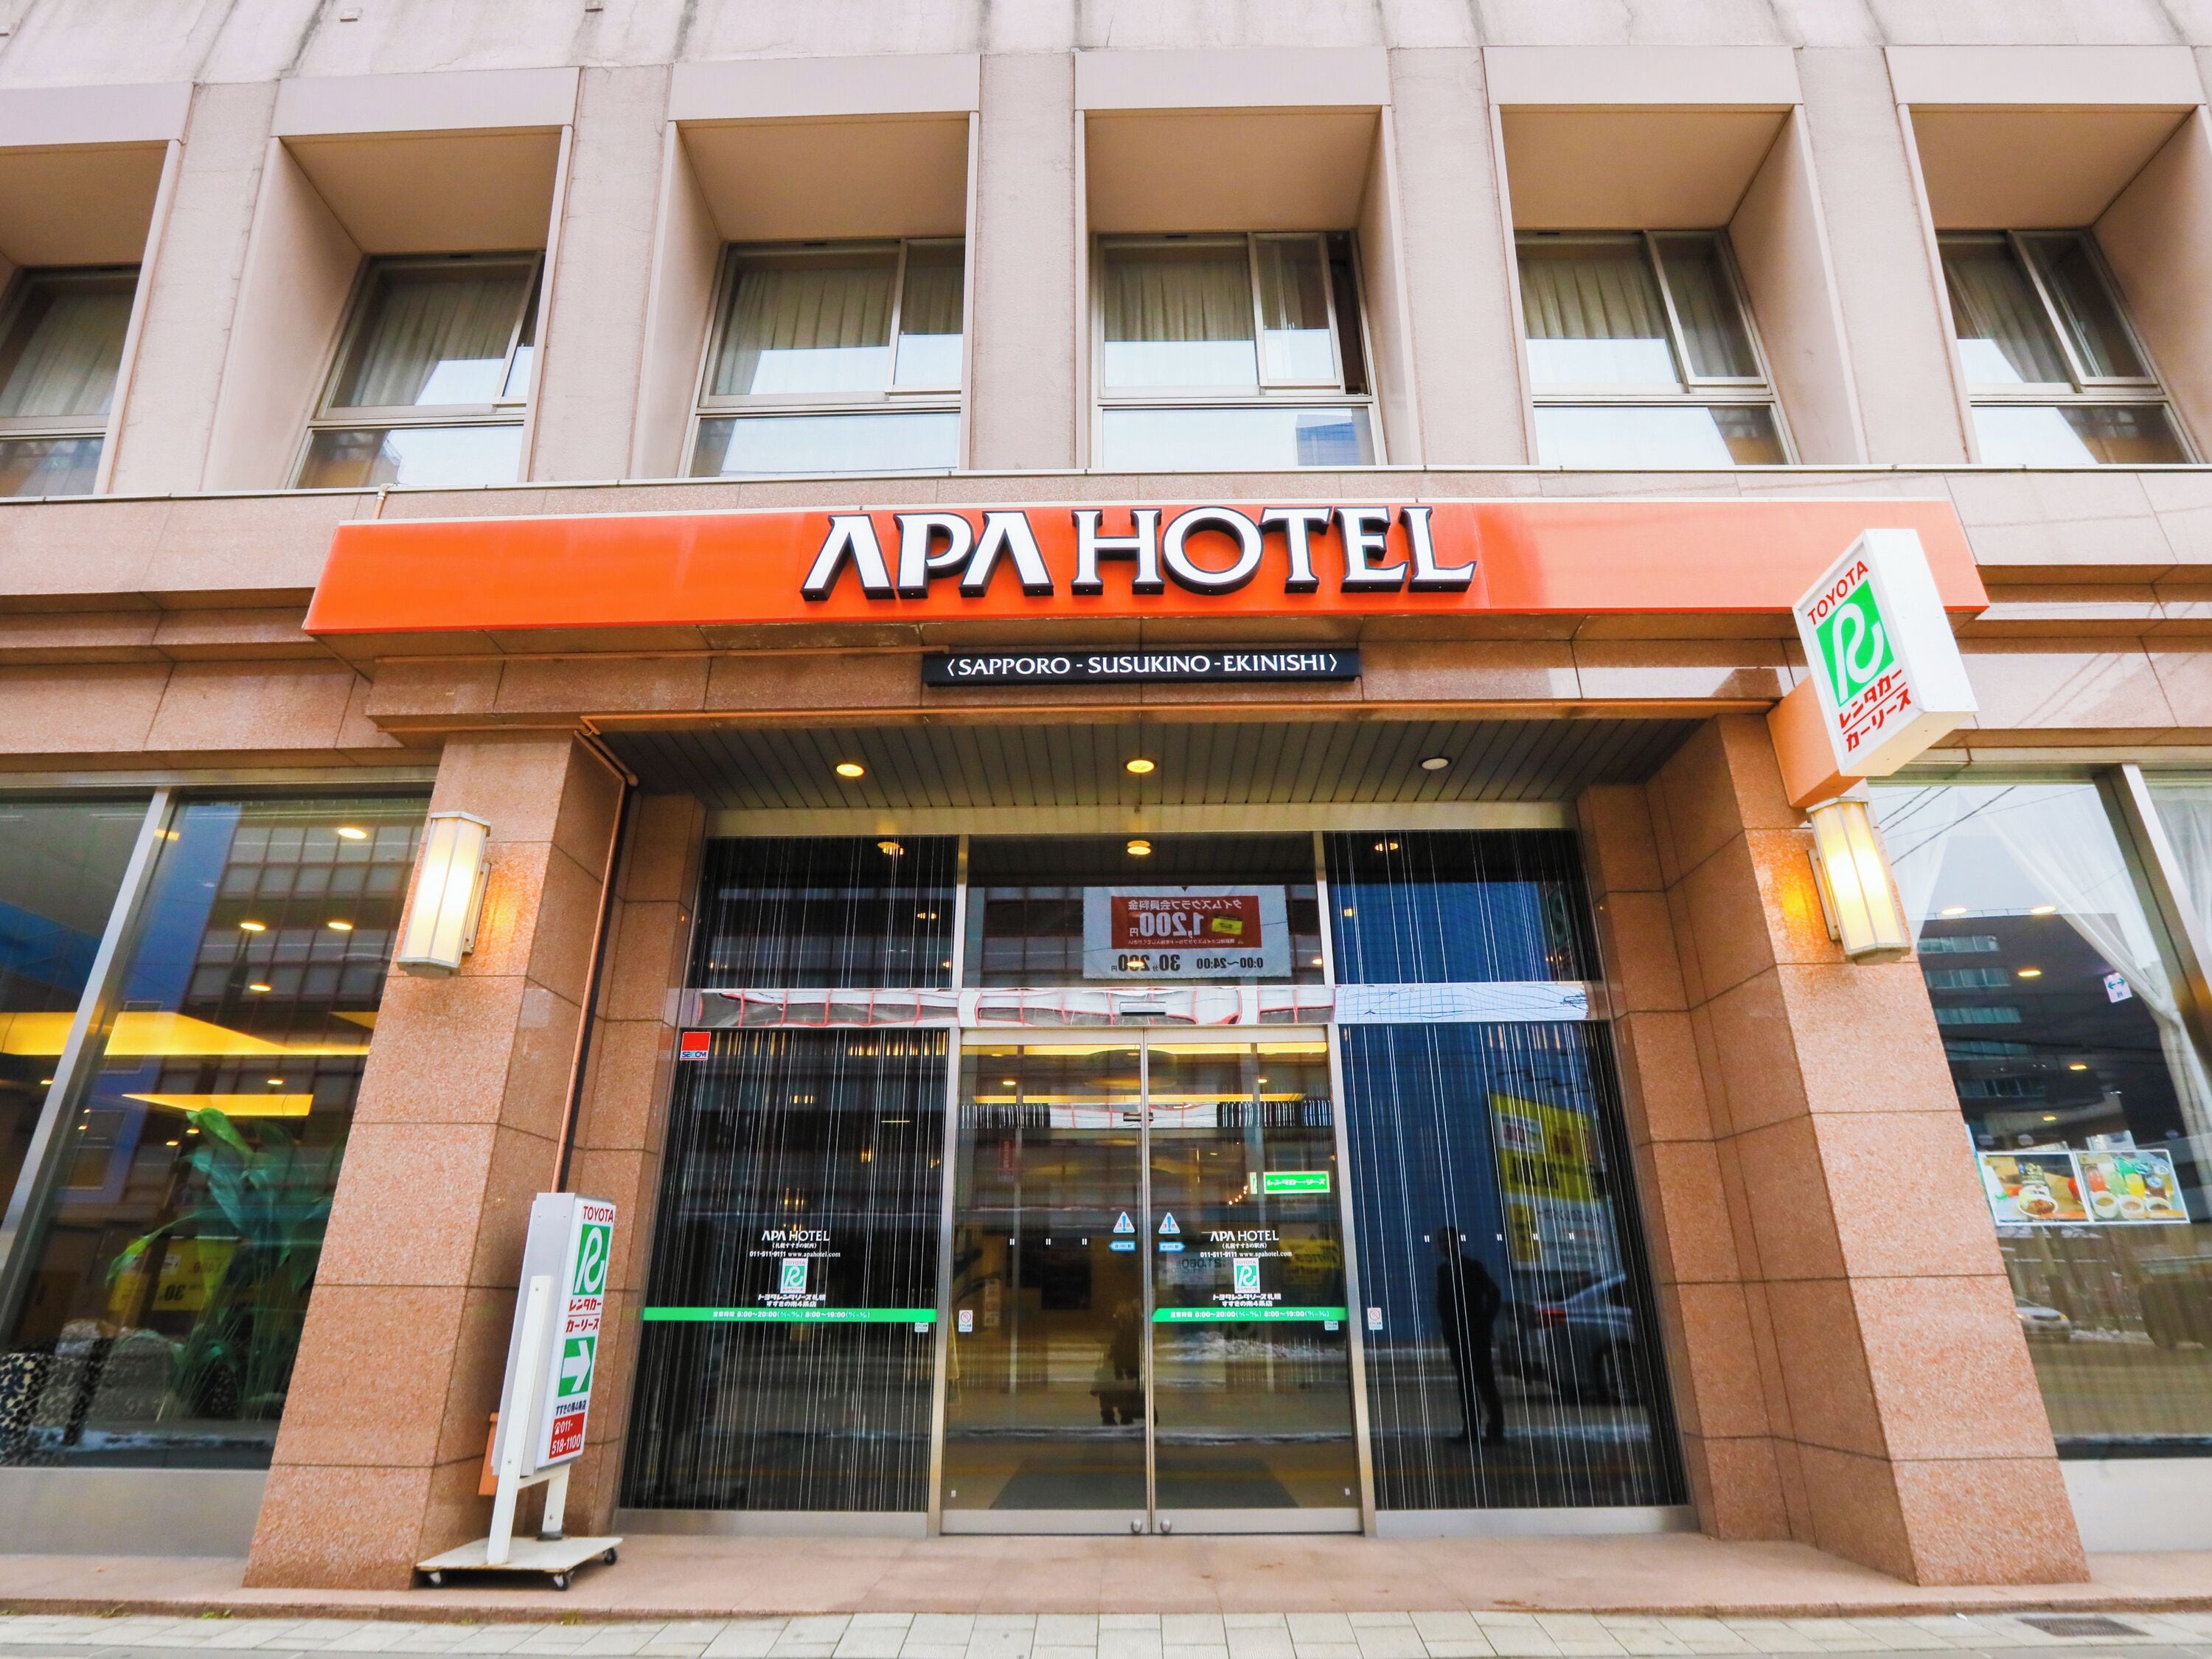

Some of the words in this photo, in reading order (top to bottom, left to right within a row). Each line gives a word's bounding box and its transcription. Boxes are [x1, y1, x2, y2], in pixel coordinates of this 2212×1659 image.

[802, 509, 1054, 600] APA
[1071, 506, 1477, 596] HOTEL
[1807, 560, 1868, 625] TOYOTA
[1838, 669, 1903, 729] レンタカー
[1846, 688, 1912, 752] カーリース
[583, 1206, 613, 1222] TOYOTA
[761, 1231, 787, 1241] APA
[788, 1231, 830, 1241] HOTEL
[1210, 1231, 1235, 1242] APA
[1238, 1230, 1279, 1241] HOTEL
[568, 1298, 602, 1312] レンタカー
[566, 1318, 599, 1333] カーリース
[551, 1433, 581, 1455] 518-1100
